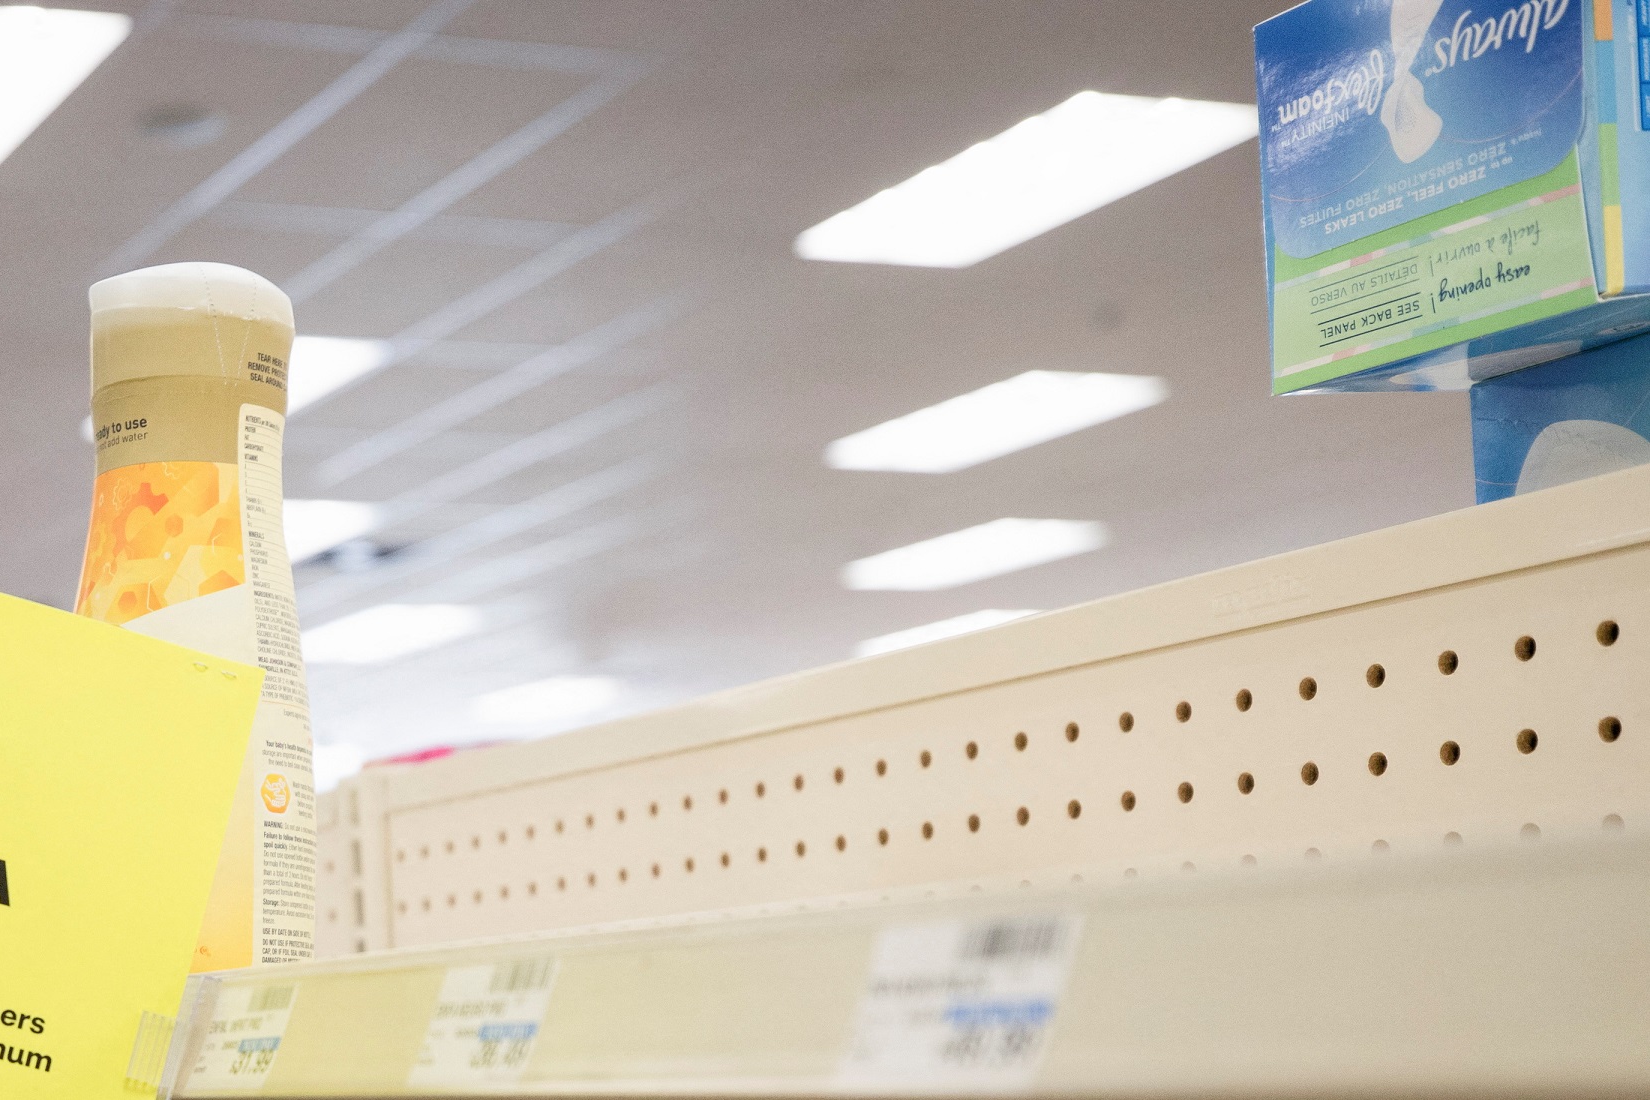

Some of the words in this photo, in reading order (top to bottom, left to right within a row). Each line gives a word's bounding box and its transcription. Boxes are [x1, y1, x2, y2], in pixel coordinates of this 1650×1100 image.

[1425, 0, 1570, 77] always
[1449, 166, 1487, 187] ZERO
[1298, 205, 1342, 229] FUITES
[1370, 197, 1404, 218] ZERO
[1325, 210, 1366, 236] LEAKS
[1499, 220, 1541, 256] facile
[1370, 265, 1419, 287] DÉTAILS
[1496, 261, 1531, 284] easy
[1351, 280, 1366, 293] AU
[1311, 288, 1348, 307] VERSO
[1397, 300, 1421, 313] SEE
[1361, 307, 1393, 324] BACK
[1320, 320, 1357, 340] PANEL
[111, 422, 122, 433] to
[125, 418, 148, 430] use
[122, 432, 149, 443] water
